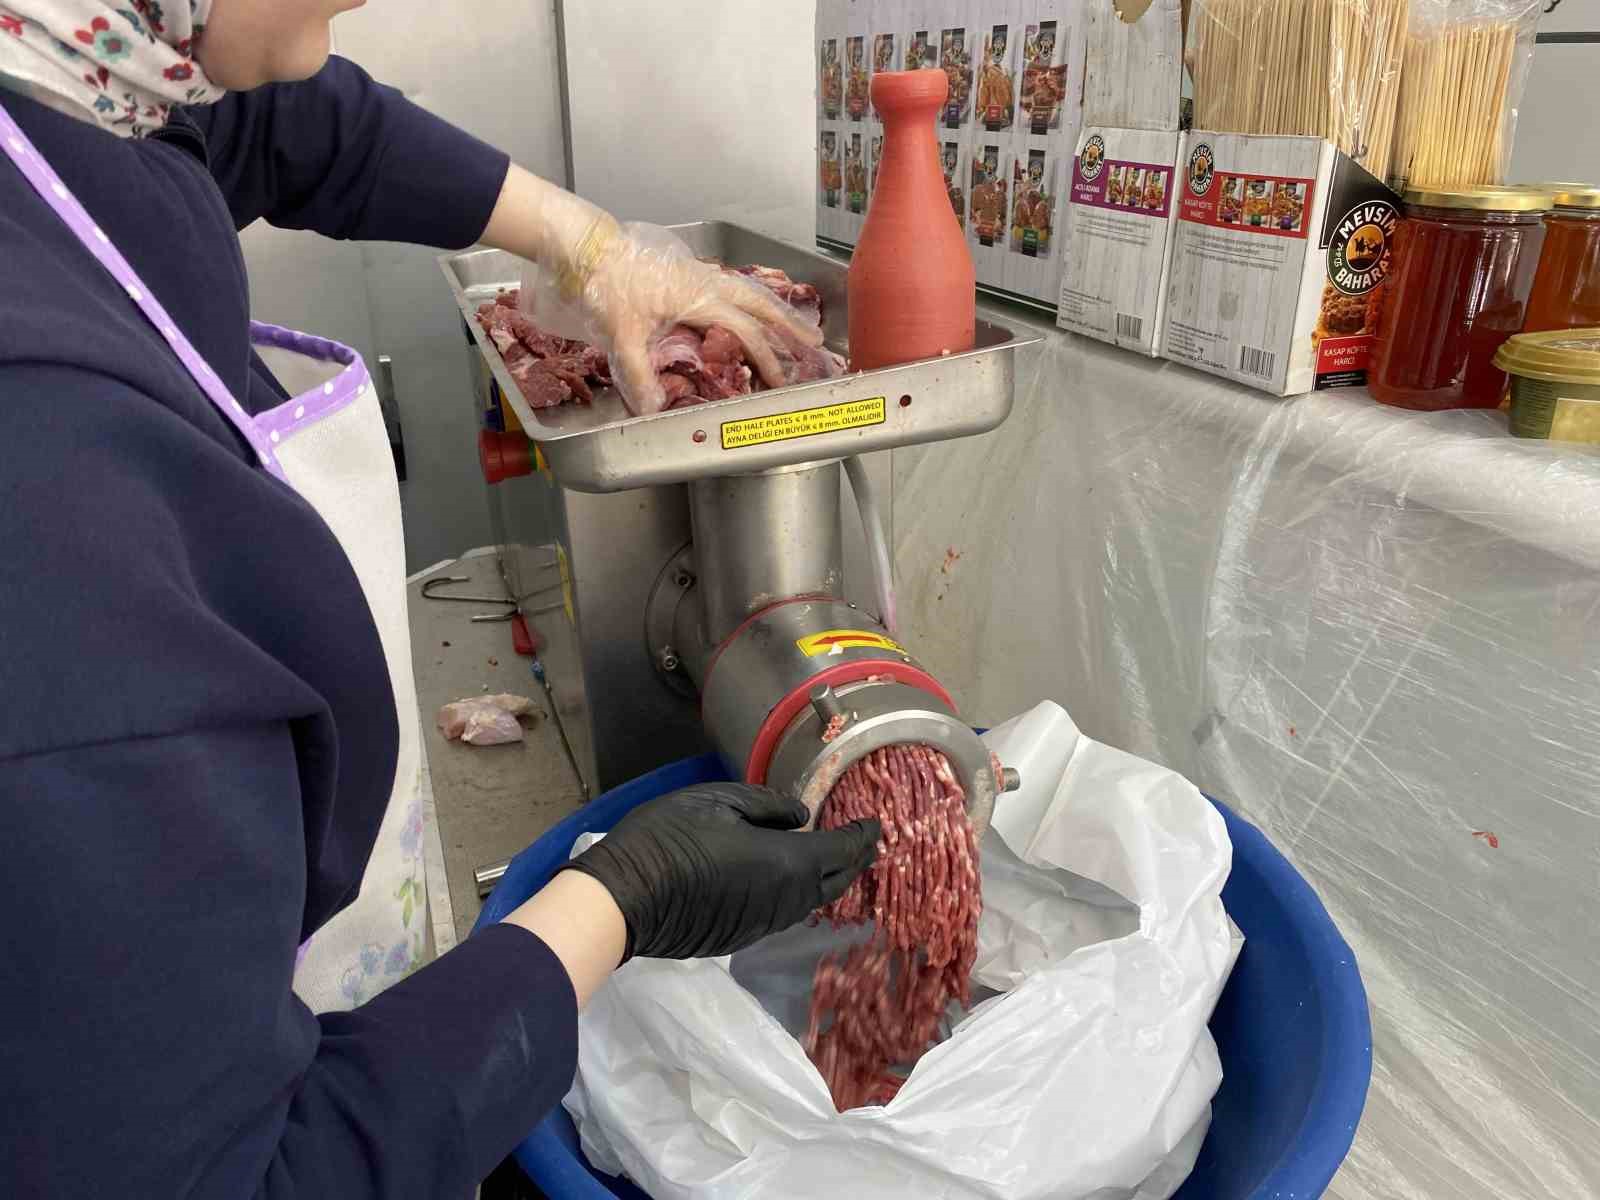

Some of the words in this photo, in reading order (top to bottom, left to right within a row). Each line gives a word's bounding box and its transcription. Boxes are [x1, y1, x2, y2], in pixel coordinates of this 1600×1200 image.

[1339, 206, 1397, 239] MEVSİM
[1335, 248, 1391, 289] BAHARAT
[1324, 347, 1346, 357] KASAP
[726, 423, 742, 434] END
[744, 421, 764, 431] HALE
[766, 417, 793, 428] PLATES
[828, 408, 843, 417] NOT
[846, 402, 881, 414] ALLOWED
[727, 434, 747, 444] AYNA
[774, 428, 785, 437] EN
